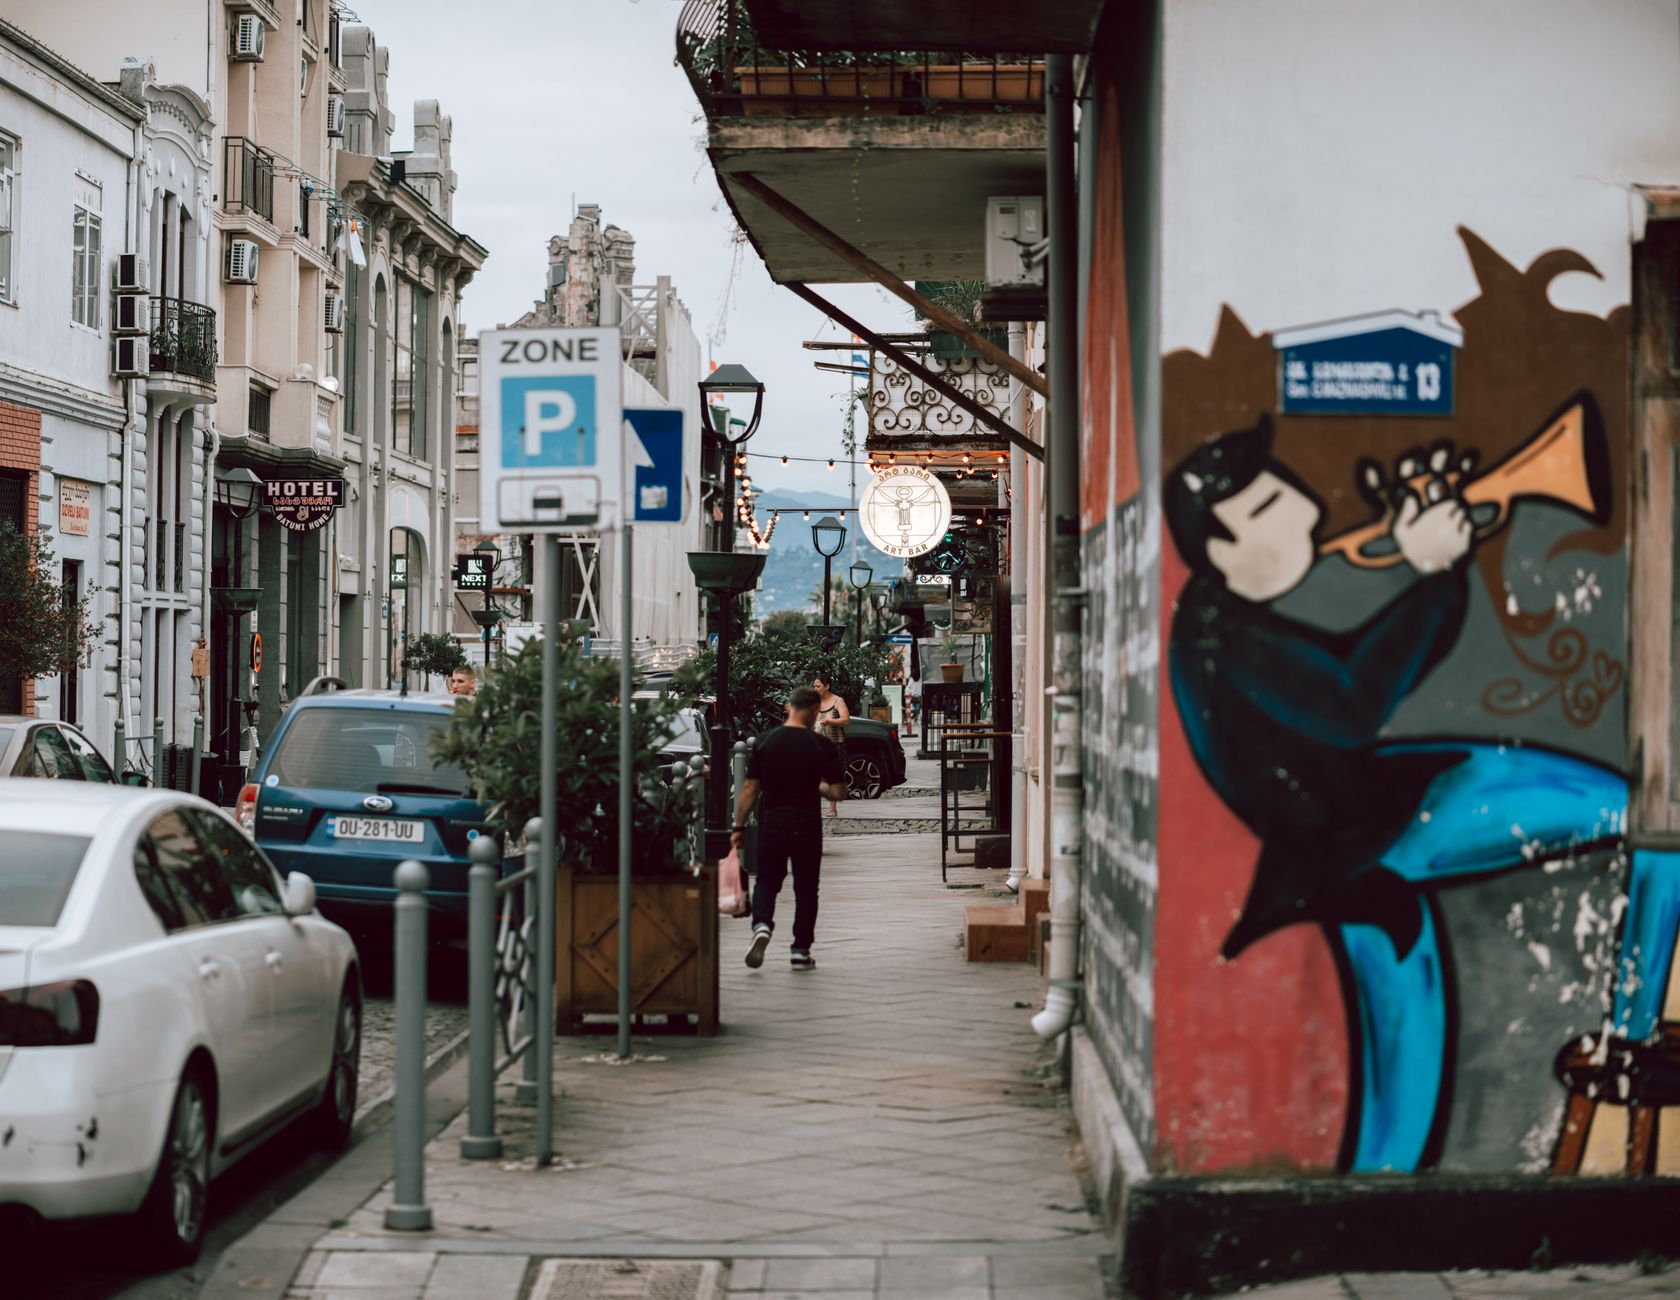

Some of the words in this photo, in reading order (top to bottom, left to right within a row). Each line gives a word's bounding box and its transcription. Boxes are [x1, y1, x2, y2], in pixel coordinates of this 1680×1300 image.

[500, 337, 599, 364] ZONE
[525, 389, 577, 457] P
[878, 468, 899, 482] არტ
[267, 482, 338, 496] HOTEL
[276, 513, 306, 531] BATUMI
[308, 513, 330, 530] HOME
[883, 544, 903, 556] ART
[908, 543, 929, 556] BAR
[461, 574, 487, 582] NEXT
[339, 818, 413, 839] OU-281-UU
